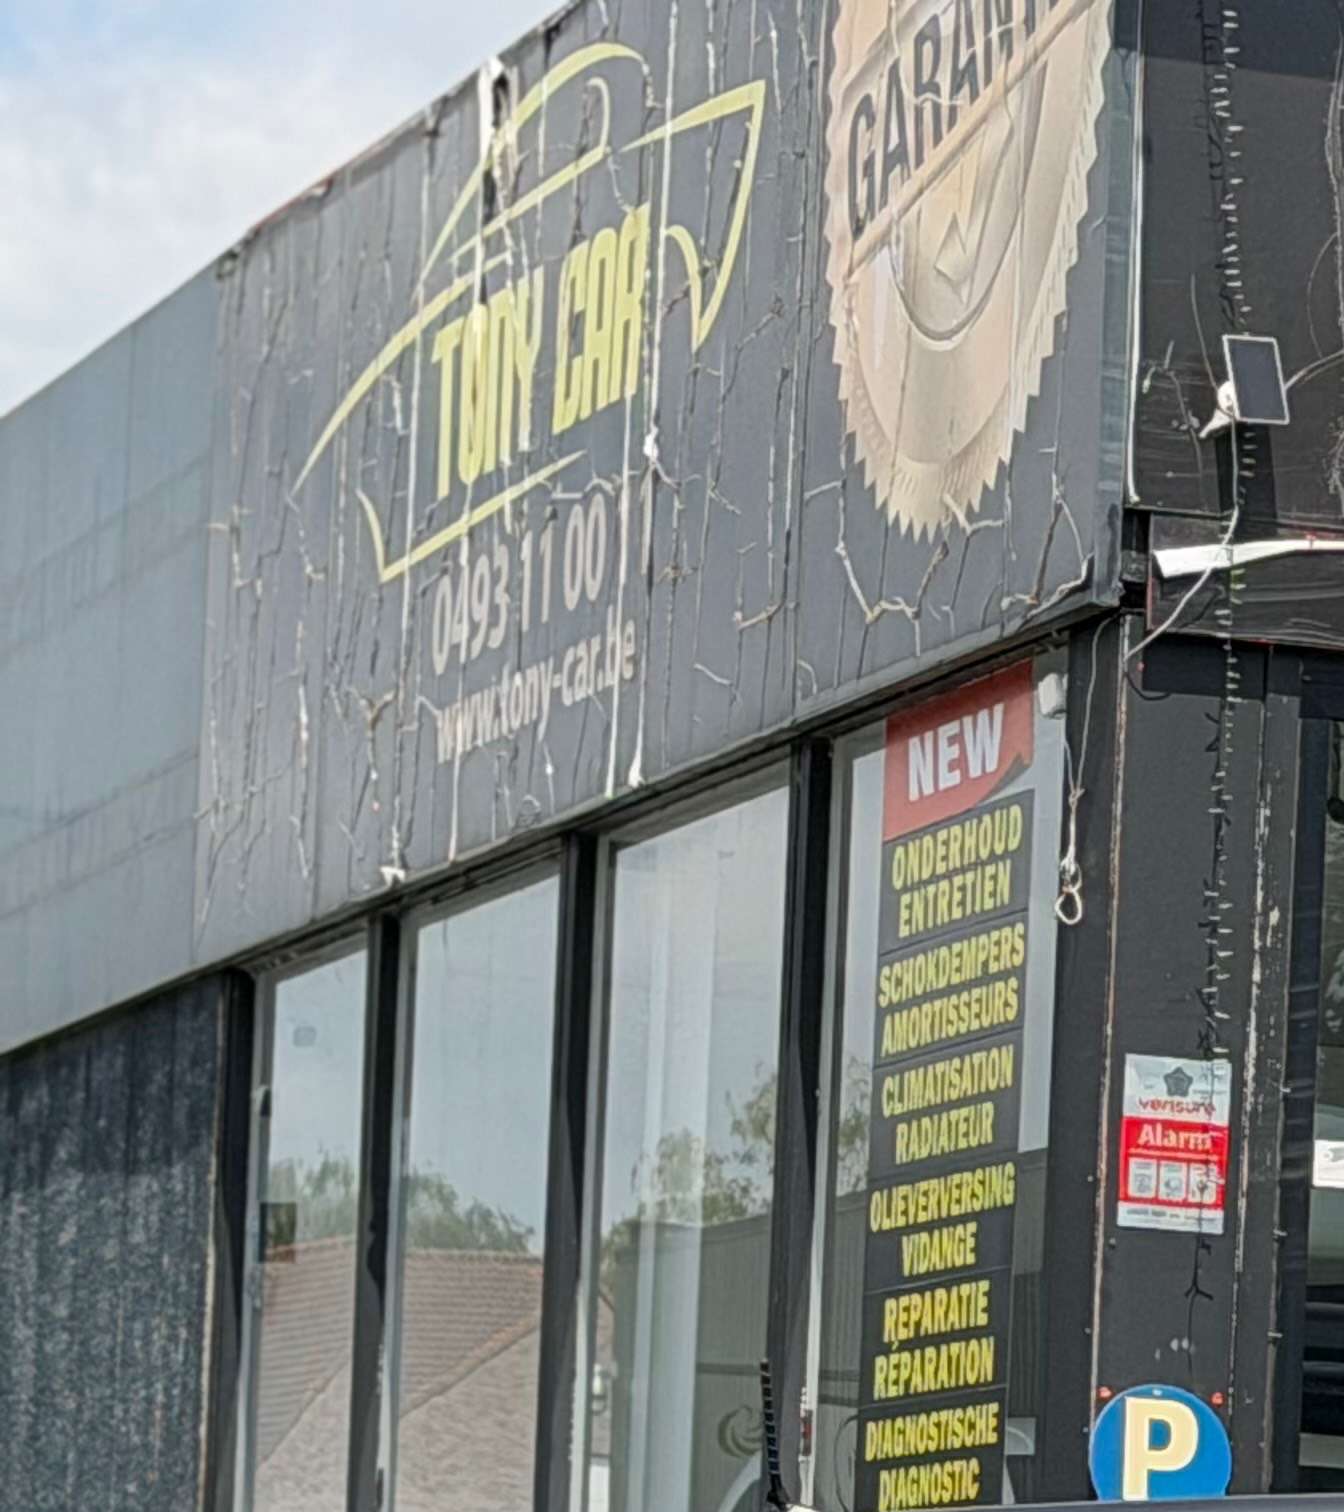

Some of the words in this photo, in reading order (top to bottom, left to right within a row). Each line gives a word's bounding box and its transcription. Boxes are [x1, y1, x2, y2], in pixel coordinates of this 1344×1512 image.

[848, 0, 1036, 238] GARAN
[431, 265, 545, 499] TONY
[552, 201, 651, 437] CAR
[564, 492, 608, 612] 00
[908, 703, 1005, 801] NEW
[892, 804, 1023, 891] ONDERHOUD
[898, 859, 1012, 938] ENTRETIEN
[879, 922, 1025, 1008] SCHOKDEMPERS
[881, 976, 1019, 1057] AMORTISSEURS
[881, 1044, 1014, 1118] CLIMATISATION
[895, 1101, 995, 1166] RADIATEUR
[1137, 1121, 1214, 1151] Alarm
[869, 1161, 1016, 1233] OLIEVERVERSING
[902, 1221, 978, 1278] VIDANGE
[883, 1279, 991, 1344] REPARATIE
[873, 1335, 995, 1401] RÉPARATION
[864, 1401, 1000, 1463] DIAGNOSTISCHE
[1120, 1396, 1199, 1500] P
